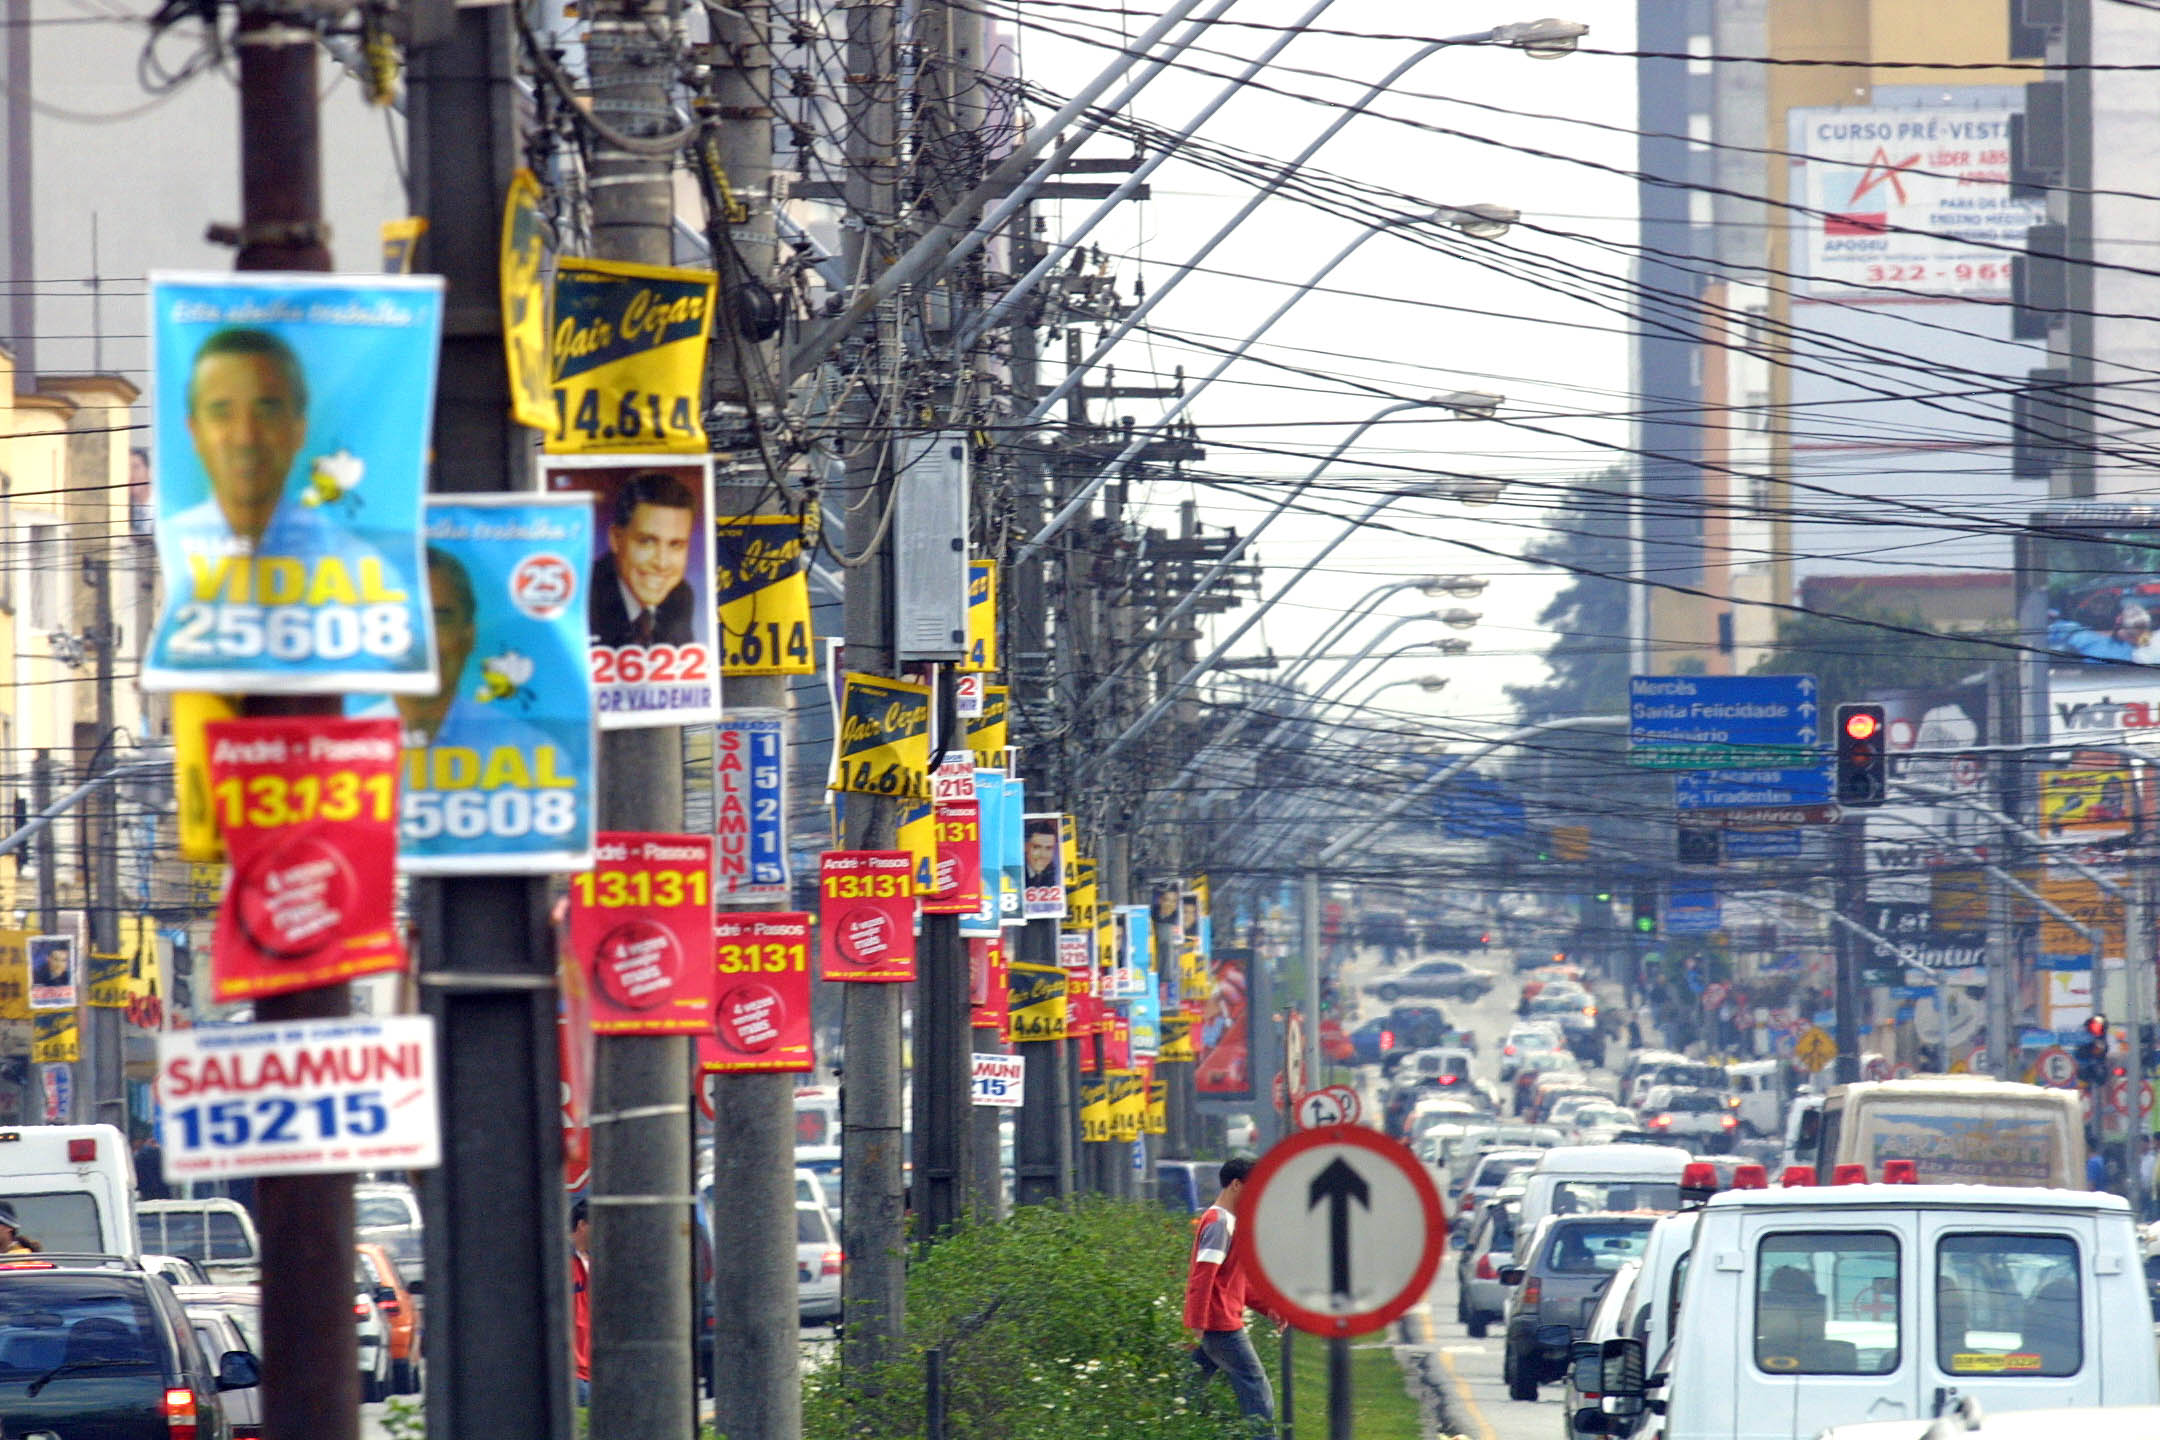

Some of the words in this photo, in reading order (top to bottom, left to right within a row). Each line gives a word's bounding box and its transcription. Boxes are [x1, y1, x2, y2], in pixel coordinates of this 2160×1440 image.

[1817, 123, 1892, 141] CURSO
[554, 388, 697, 442] 14.614
[187, 554, 409, 607] VIDAL
[519, 564, 566, 600] 25
[166, 602, 412, 661] 25608
[591, 647, 708, 684] 2622
[628, 687, 712, 711] VALDEMIR
[959, 677, 977, 696] 2
[1632, 679, 1697, 697] Mercês
[1633, 702, 1688, 720] Santa
[1691, 702, 1790, 720] Felicidade
[403, 745, 577, 791] IDAL
[214, 770, 395, 828] 13.131
[402, 788, 577, 839] 5608
[1704, 788, 1793, 804] Tiradentes
[643, 842, 706, 861] Passos
[573, 869, 708, 908] 13.131
[823, 874, 912, 899] 13.131
[915, 855, 933, 890] 4
[1024, 886, 1062, 903] 622
[753, 922, 806, 936] Passos
[718, 943, 806, 974] 3.131
[166, 1043, 422, 1098] SALAMUNI
[171, 1089, 391, 1151] 15215
